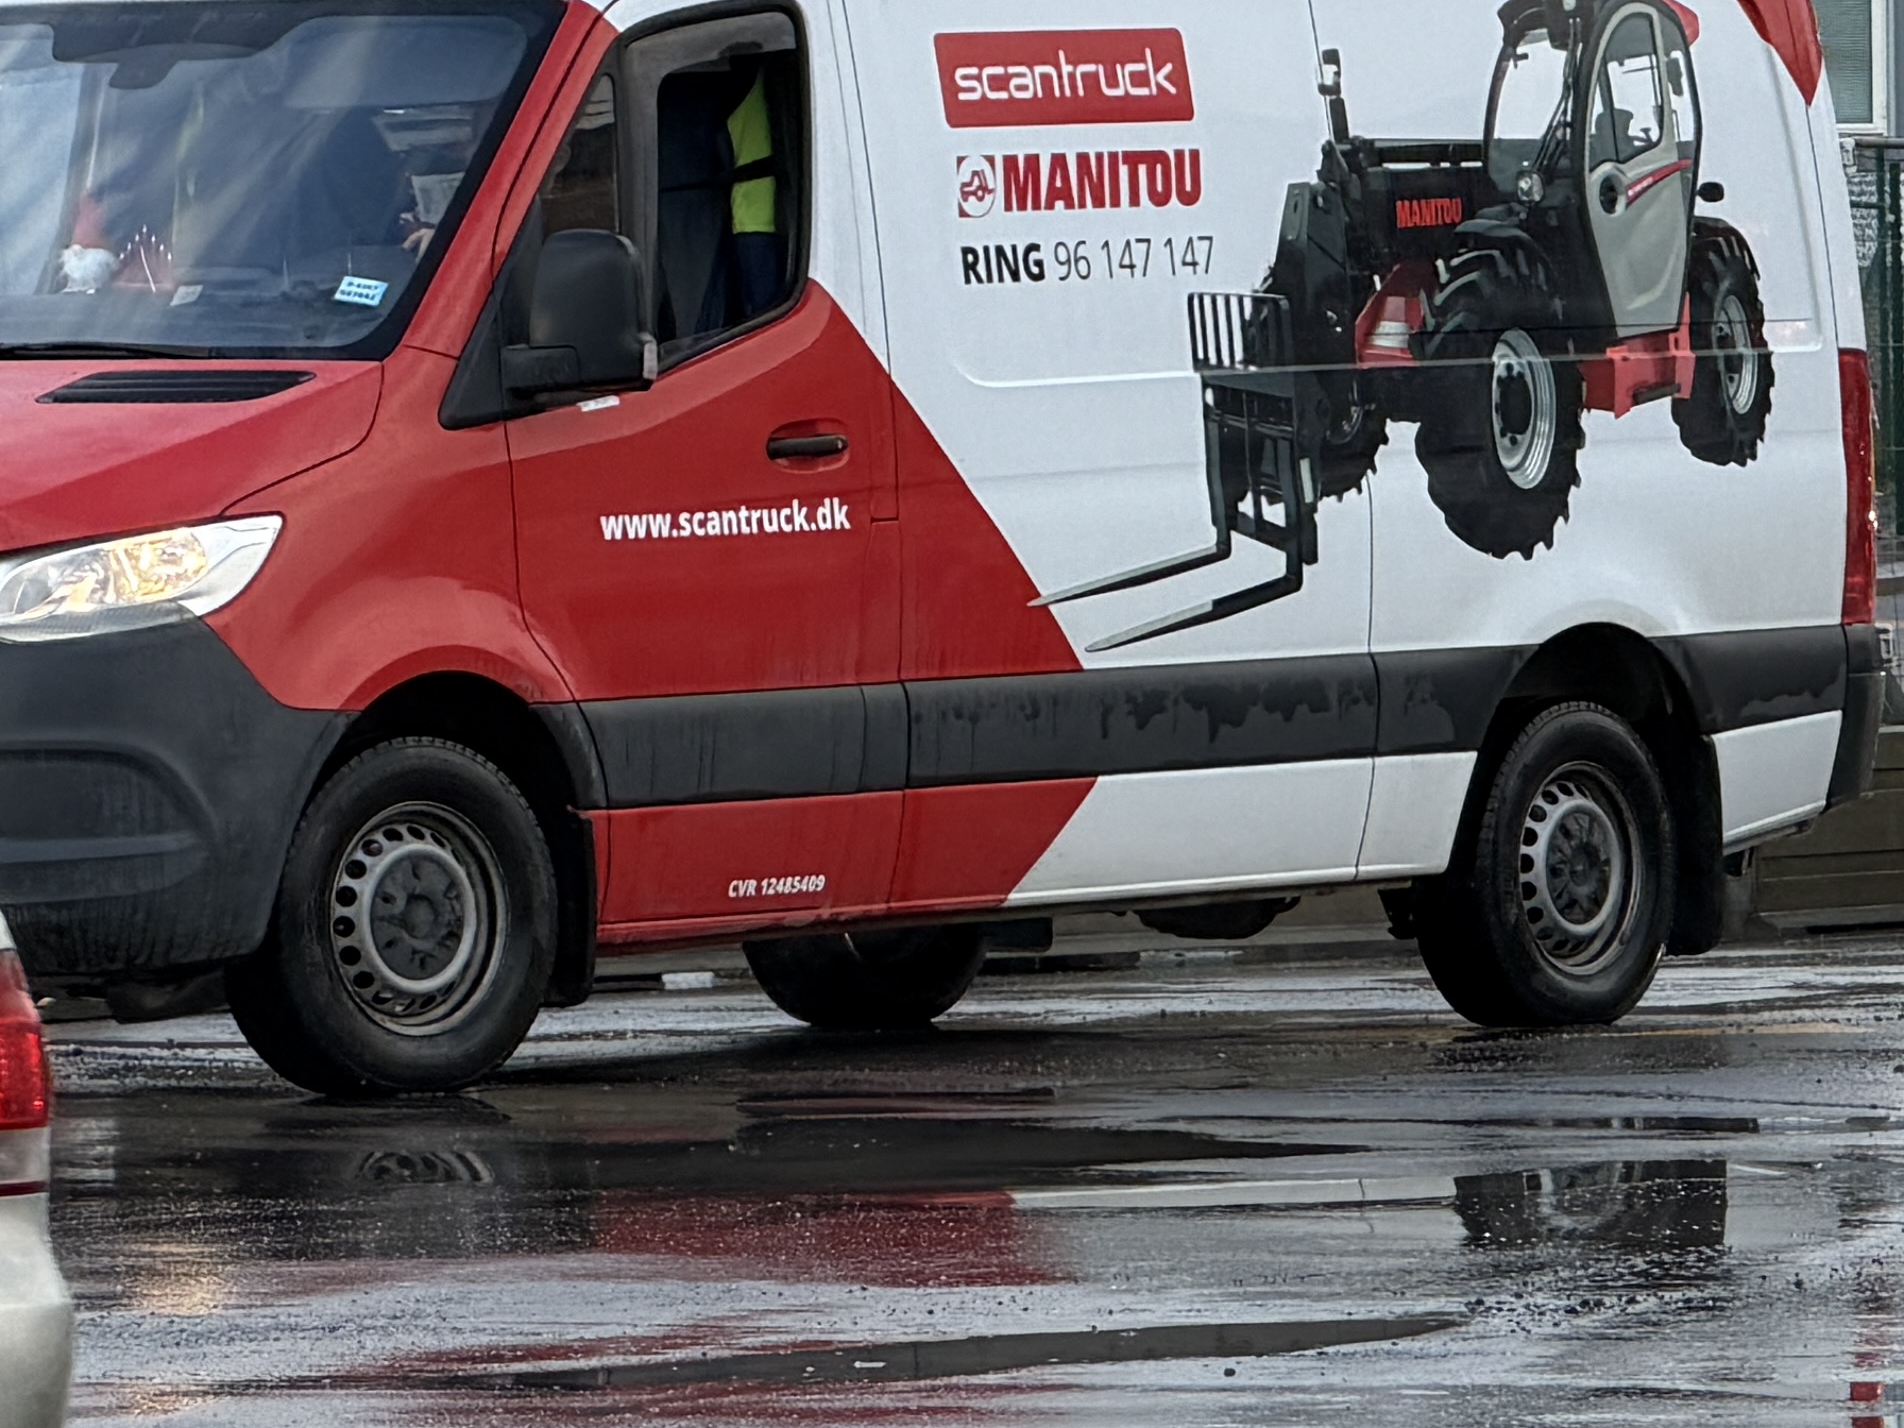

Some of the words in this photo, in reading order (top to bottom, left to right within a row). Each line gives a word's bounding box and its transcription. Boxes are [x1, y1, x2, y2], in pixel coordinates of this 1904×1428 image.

[954, 47, 1177, 100] scantruck
[1002, 149, 1202, 212] MANITOU
[1396, 198, 1462, 228] MANITOU
[960, 242, 1046, 285] RING
[1054, 240, 1091, 281] 96
[1101, 238, 1151, 279] 147
[1163, 236, 1213, 276] 147
[600, 497, 851, 540] www.scantruck.dk
[728, 879, 757, 898] CVR
